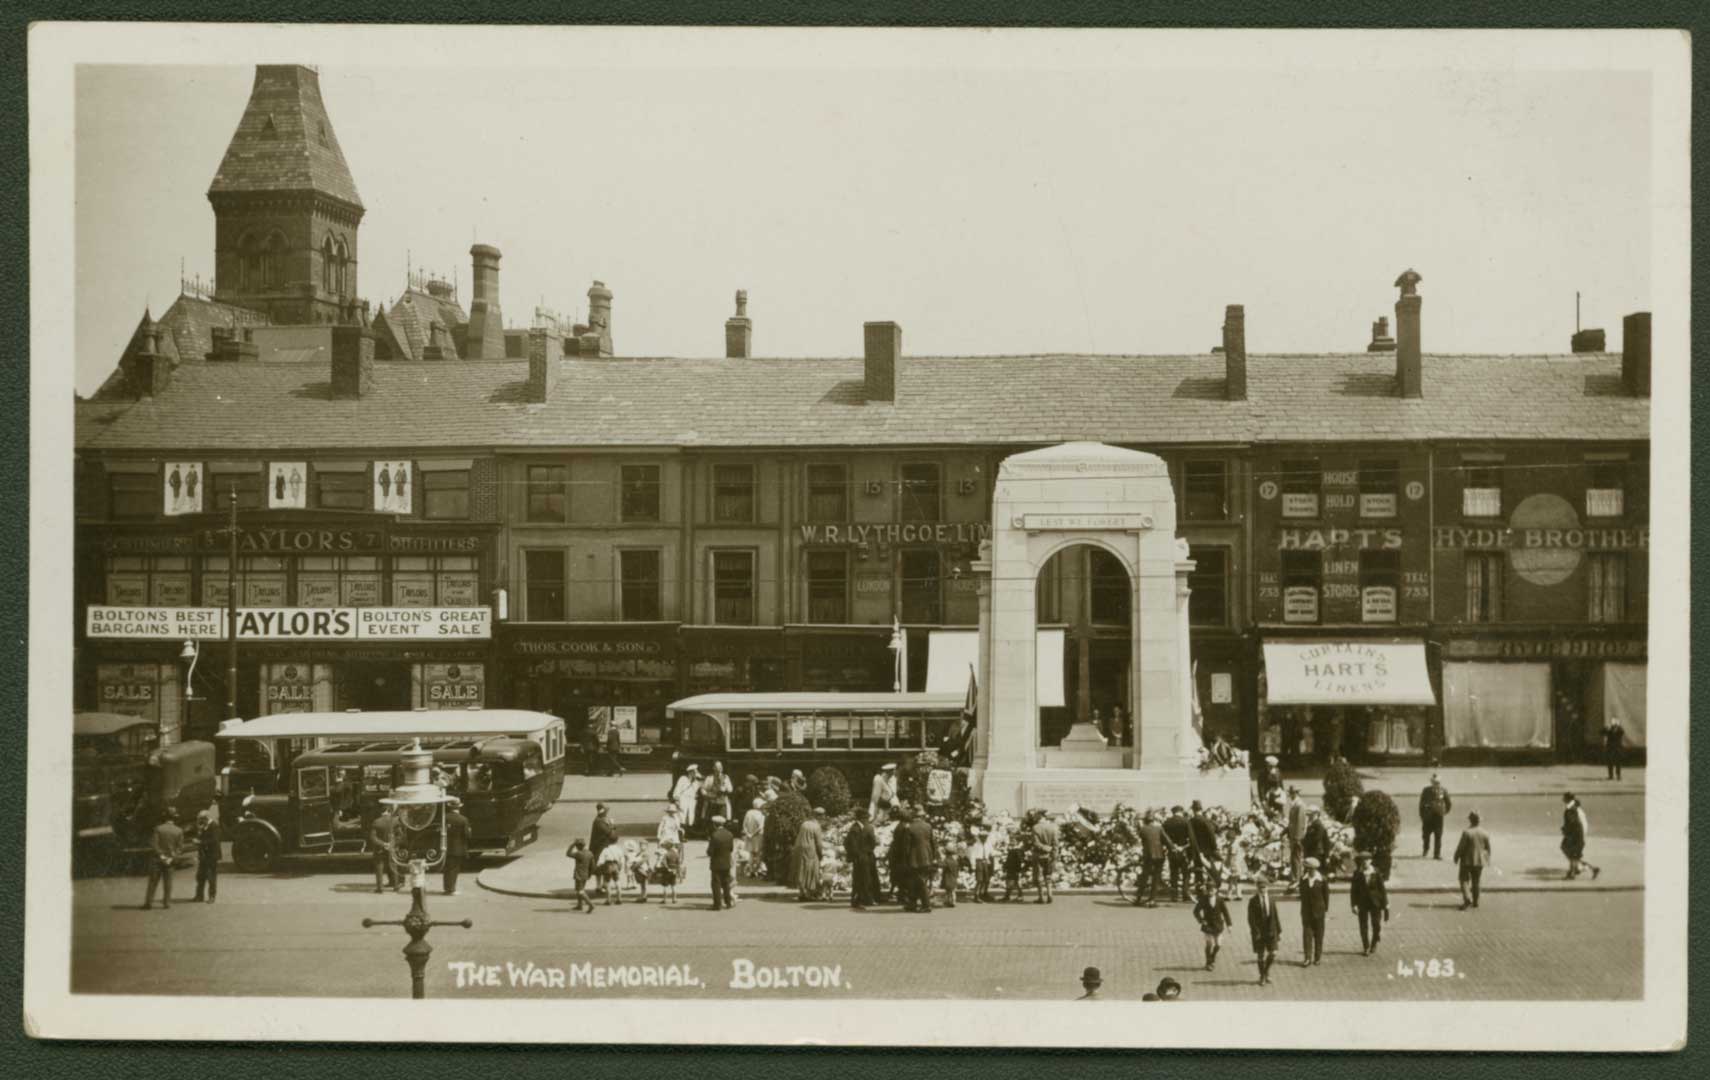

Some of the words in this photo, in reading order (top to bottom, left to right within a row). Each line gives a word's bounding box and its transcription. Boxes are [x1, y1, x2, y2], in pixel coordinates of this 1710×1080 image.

[1325, 494, 1355, 508] HOLD
[175, 611, 215, 623] BEST
[228, 608, 350, 635] AYLOR'S
[440, 611, 487, 622] GREAT
[91, 623, 169, 634] BARGAINS
[178, 623, 217, 635] HERE
[368, 624, 419, 635] EVENT
[438, 624, 480, 635] SALE
[561, 641, 600, 653] COOK
[616, 640, 644, 654] SON
[103, 685, 153, 700] SALE
[430, 685, 480, 700] SALE
